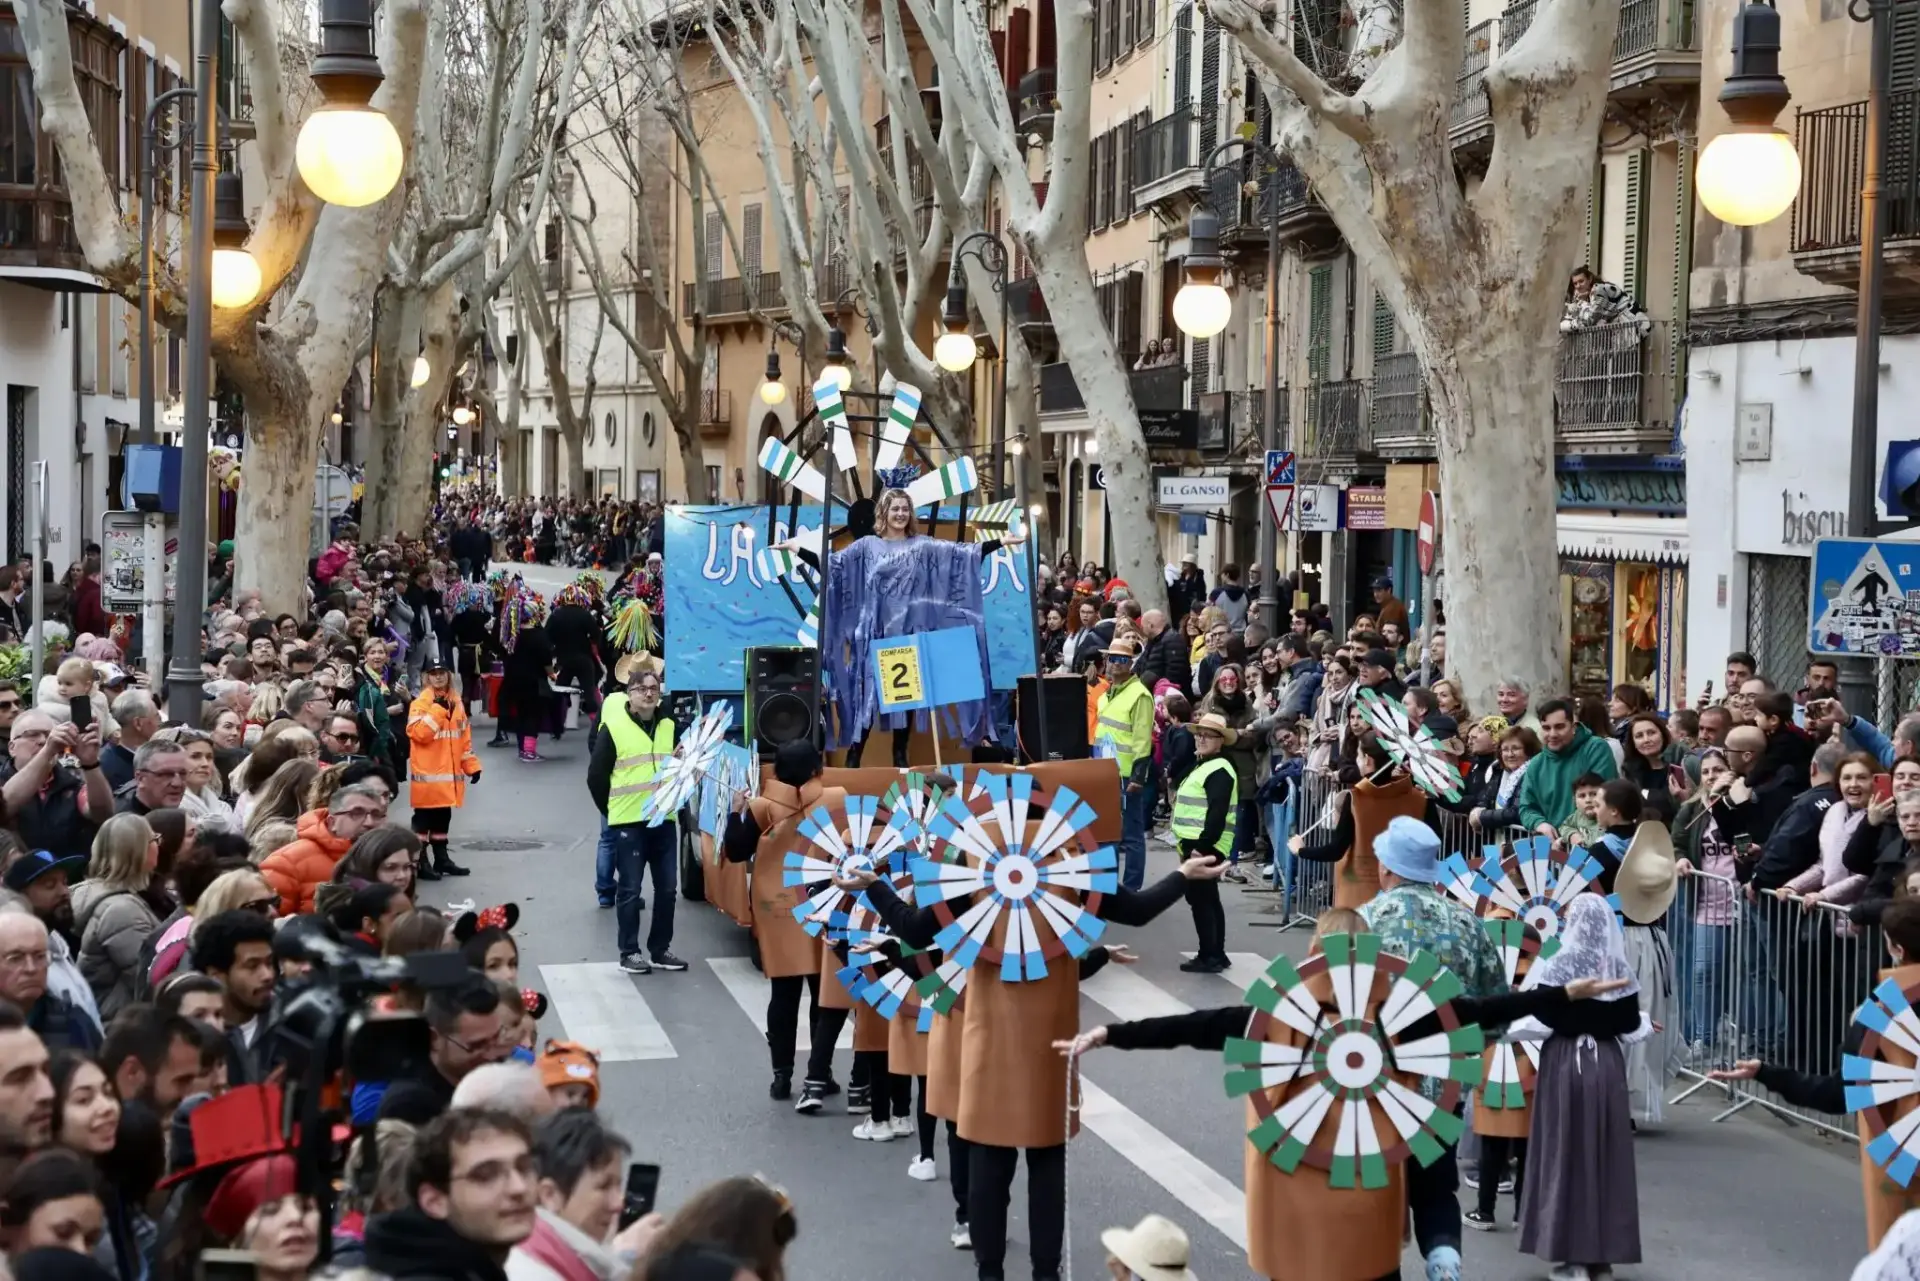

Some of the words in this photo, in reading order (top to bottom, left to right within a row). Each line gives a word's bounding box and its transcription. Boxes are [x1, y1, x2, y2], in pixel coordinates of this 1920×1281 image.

[1163, 486, 1176, 495] EL
[1180, 485, 1225, 495] GANSO
[1782, 488, 1845, 544] biscu
[702, 520, 763, 590] LA
[880, 648, 912, 657] COMPARSA
[891, 663, 910, 689] 2
